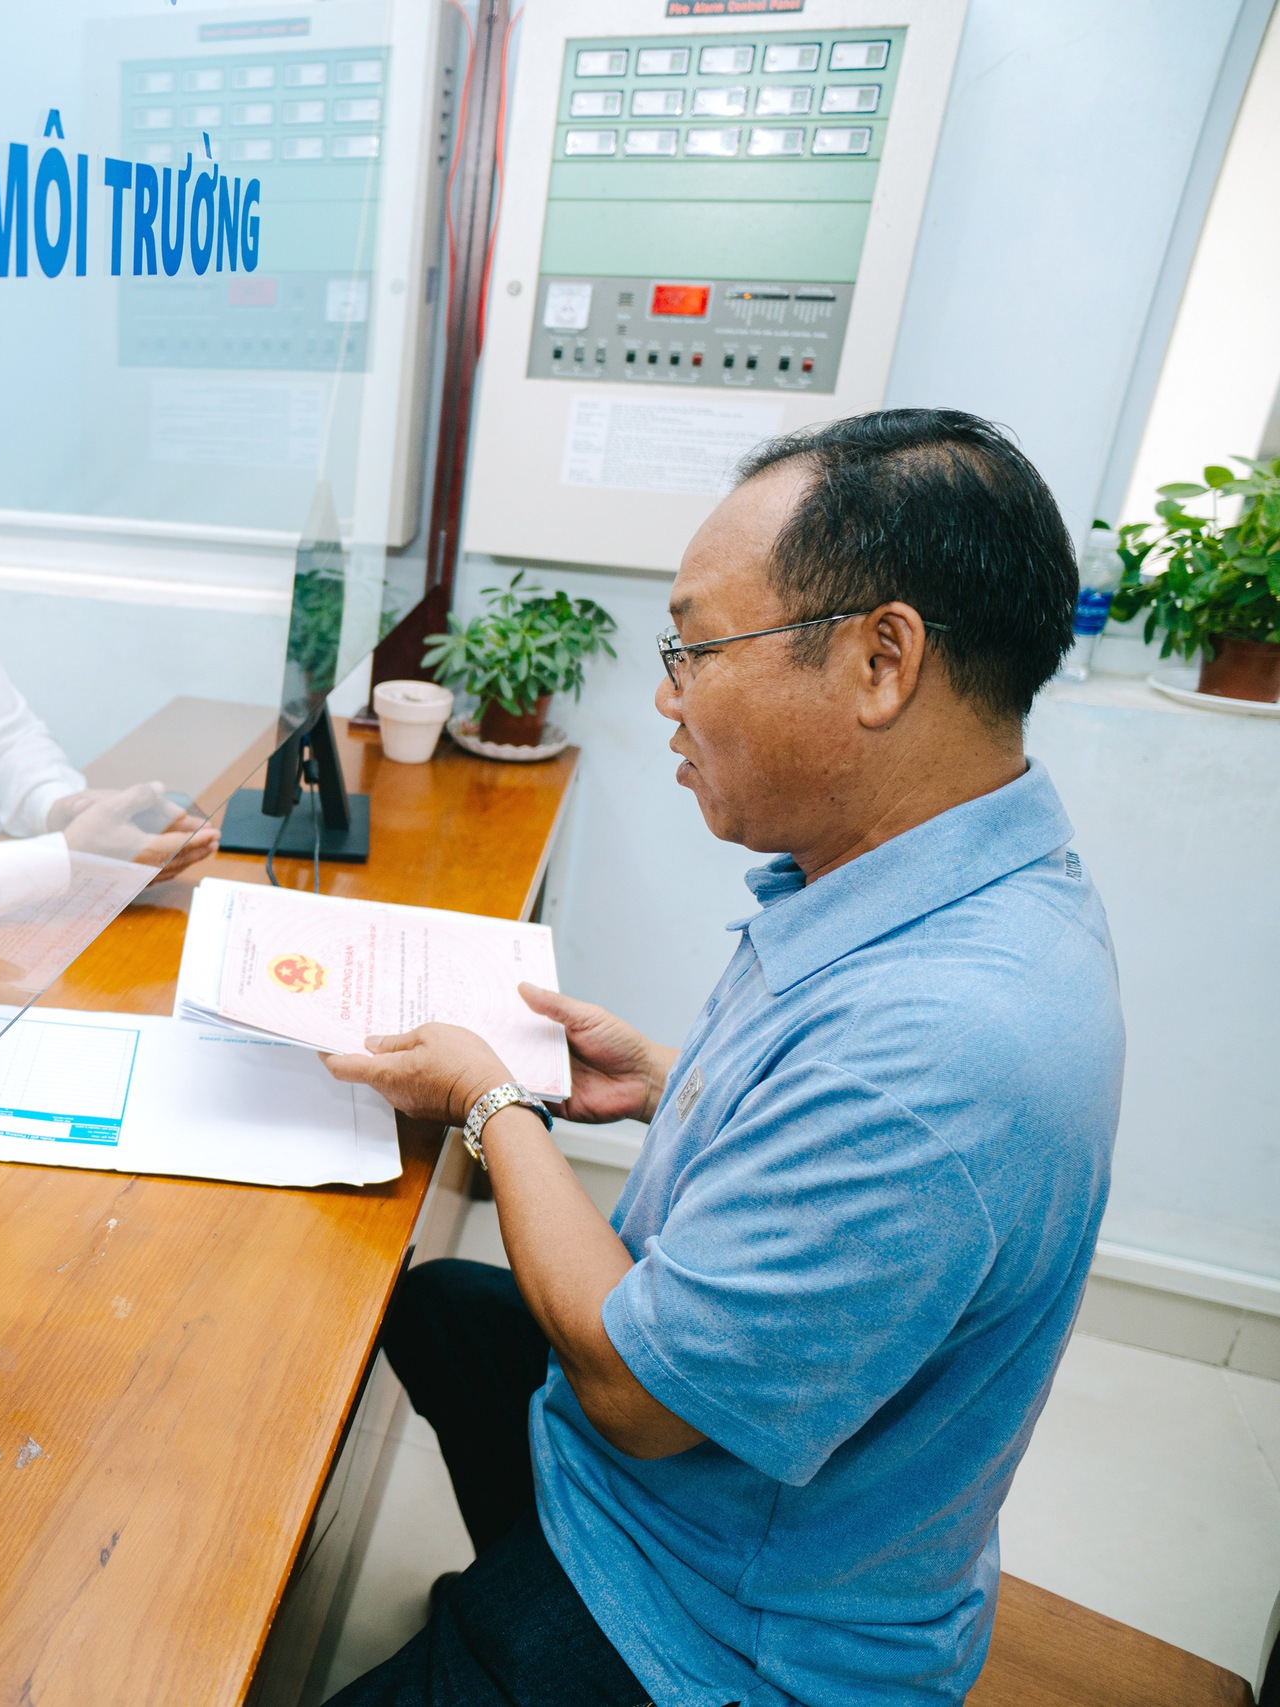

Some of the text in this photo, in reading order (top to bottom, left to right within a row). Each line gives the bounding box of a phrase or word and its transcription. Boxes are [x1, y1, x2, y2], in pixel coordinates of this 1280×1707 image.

[669, 0, 802, 15] Fire Alarm Control Panel
[104, 132, 261, 277] TRƯỜNG
